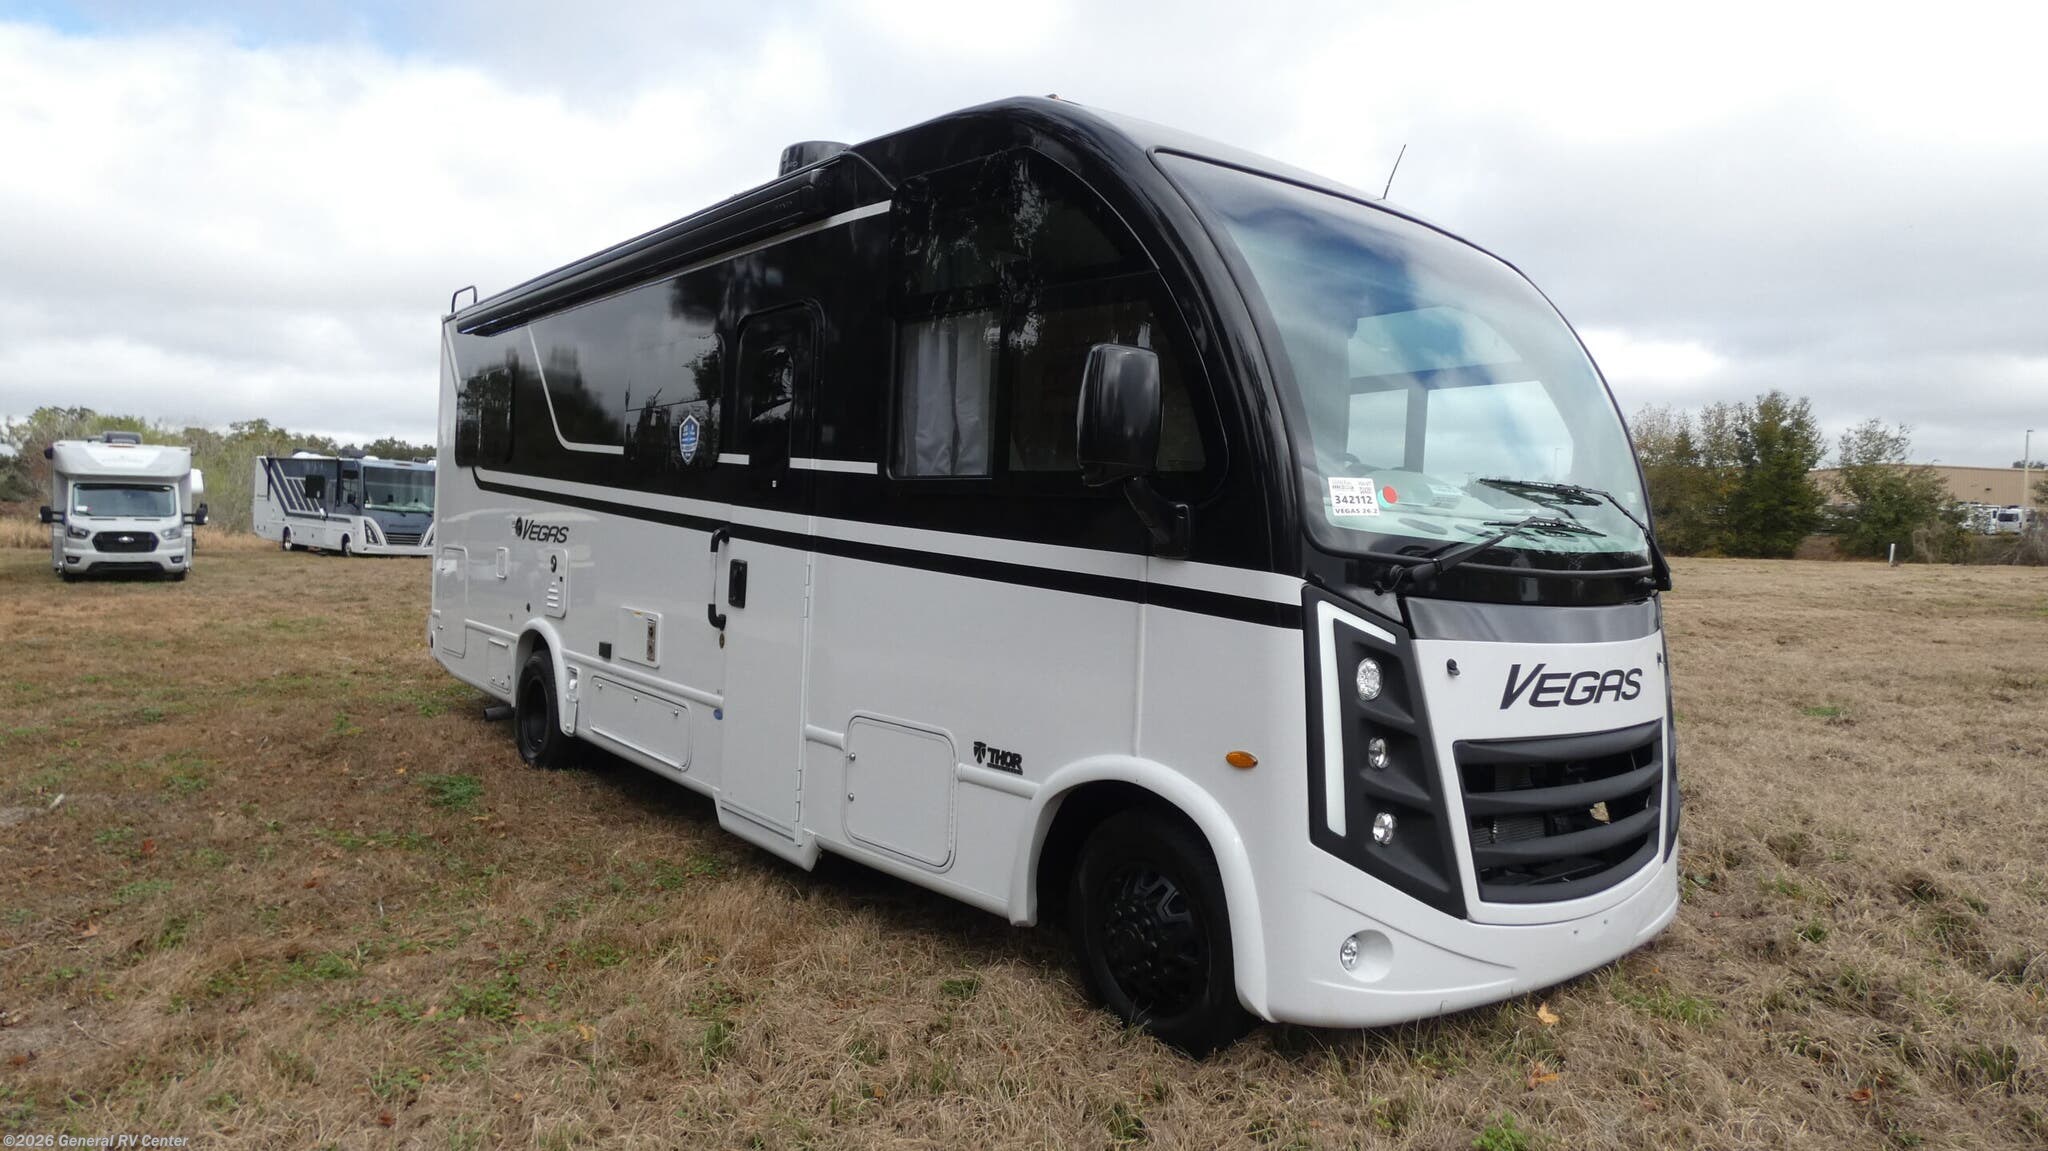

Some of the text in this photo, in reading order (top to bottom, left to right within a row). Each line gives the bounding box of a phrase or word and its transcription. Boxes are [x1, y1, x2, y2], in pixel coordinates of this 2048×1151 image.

[1334, 495, 1373, 505] 342112
[522, 519, 569, 543] VEGAS
[1500, 663, 1642, 709] VEGAS
[987, 746, 1023, 771] THOR
